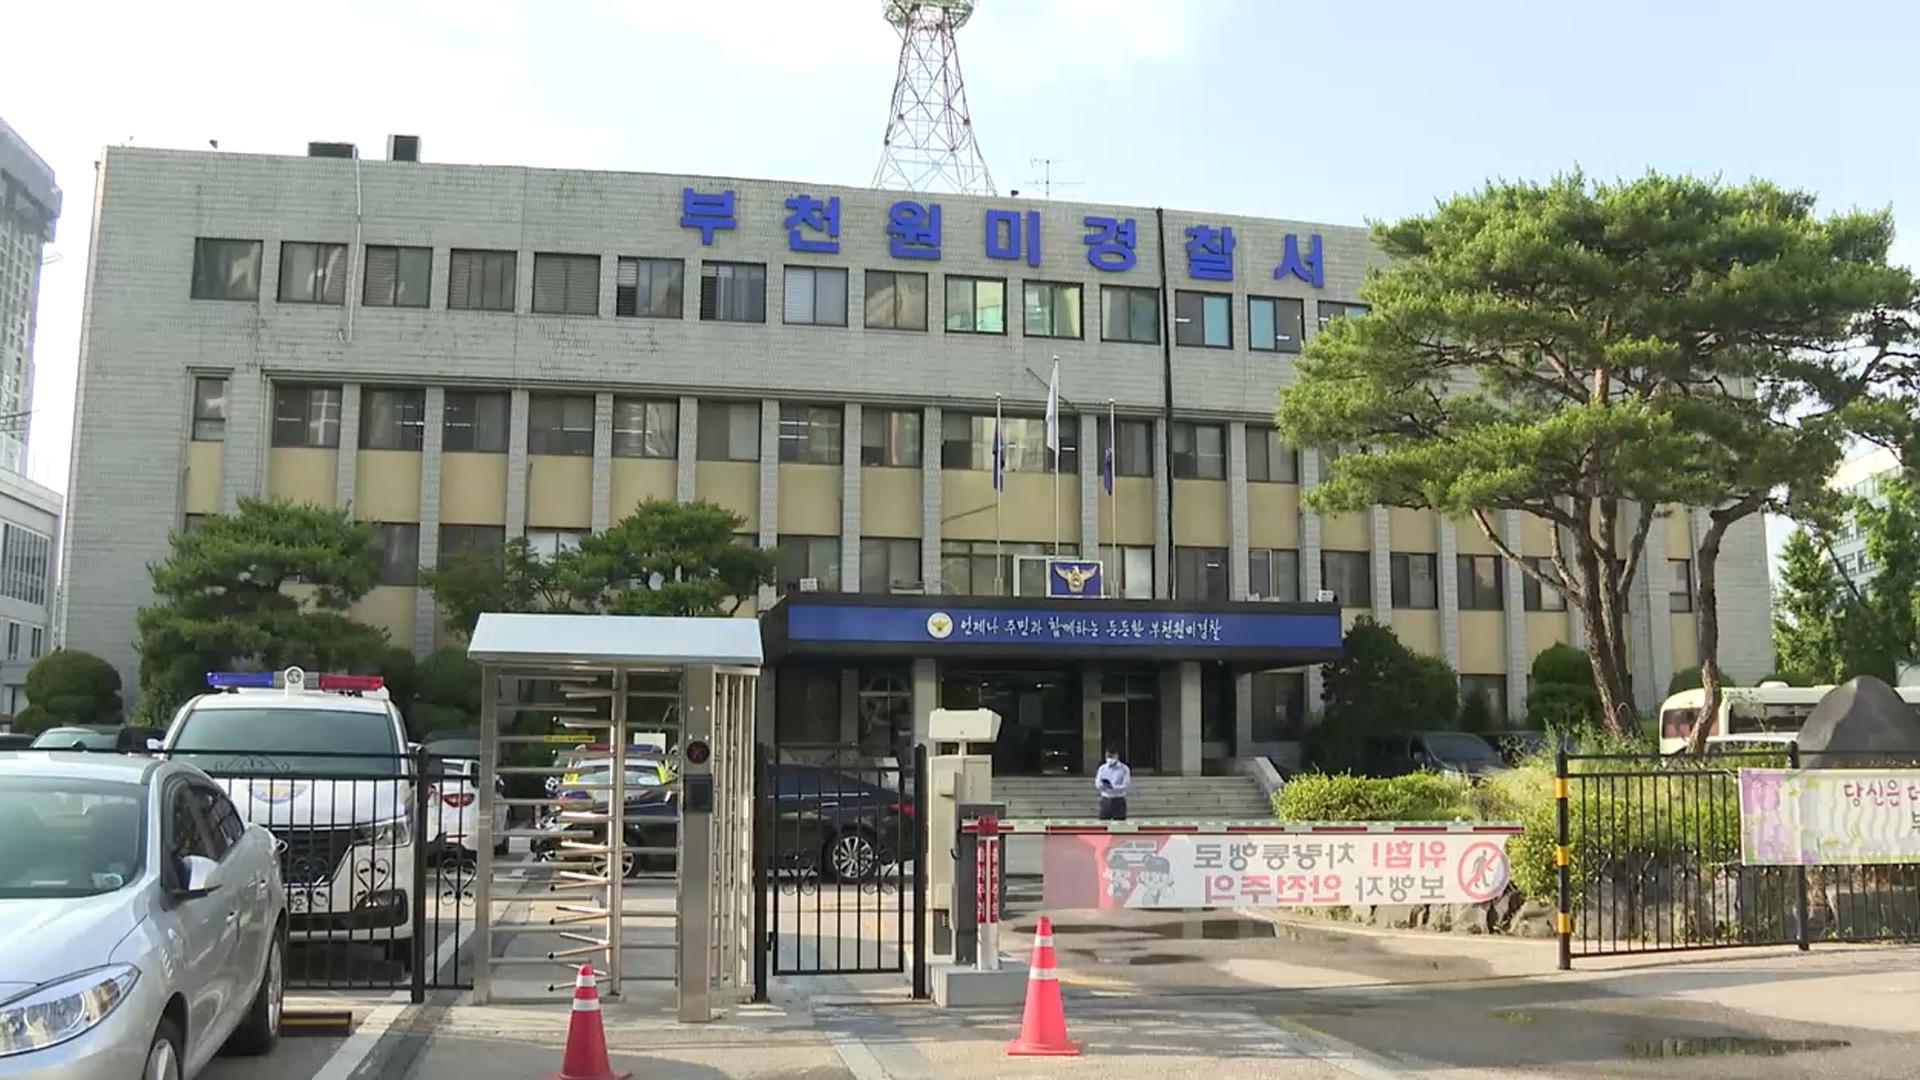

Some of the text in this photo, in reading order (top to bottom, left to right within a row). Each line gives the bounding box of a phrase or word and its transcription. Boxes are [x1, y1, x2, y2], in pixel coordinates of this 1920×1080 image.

[680, 186, 1324, 289] 부천원미경찰서
[960, 615, 1222, 641] 언제나 주민과 함께하는 든든한 부천원미경찰
[1843, 779, 1900, 807] 당신은
